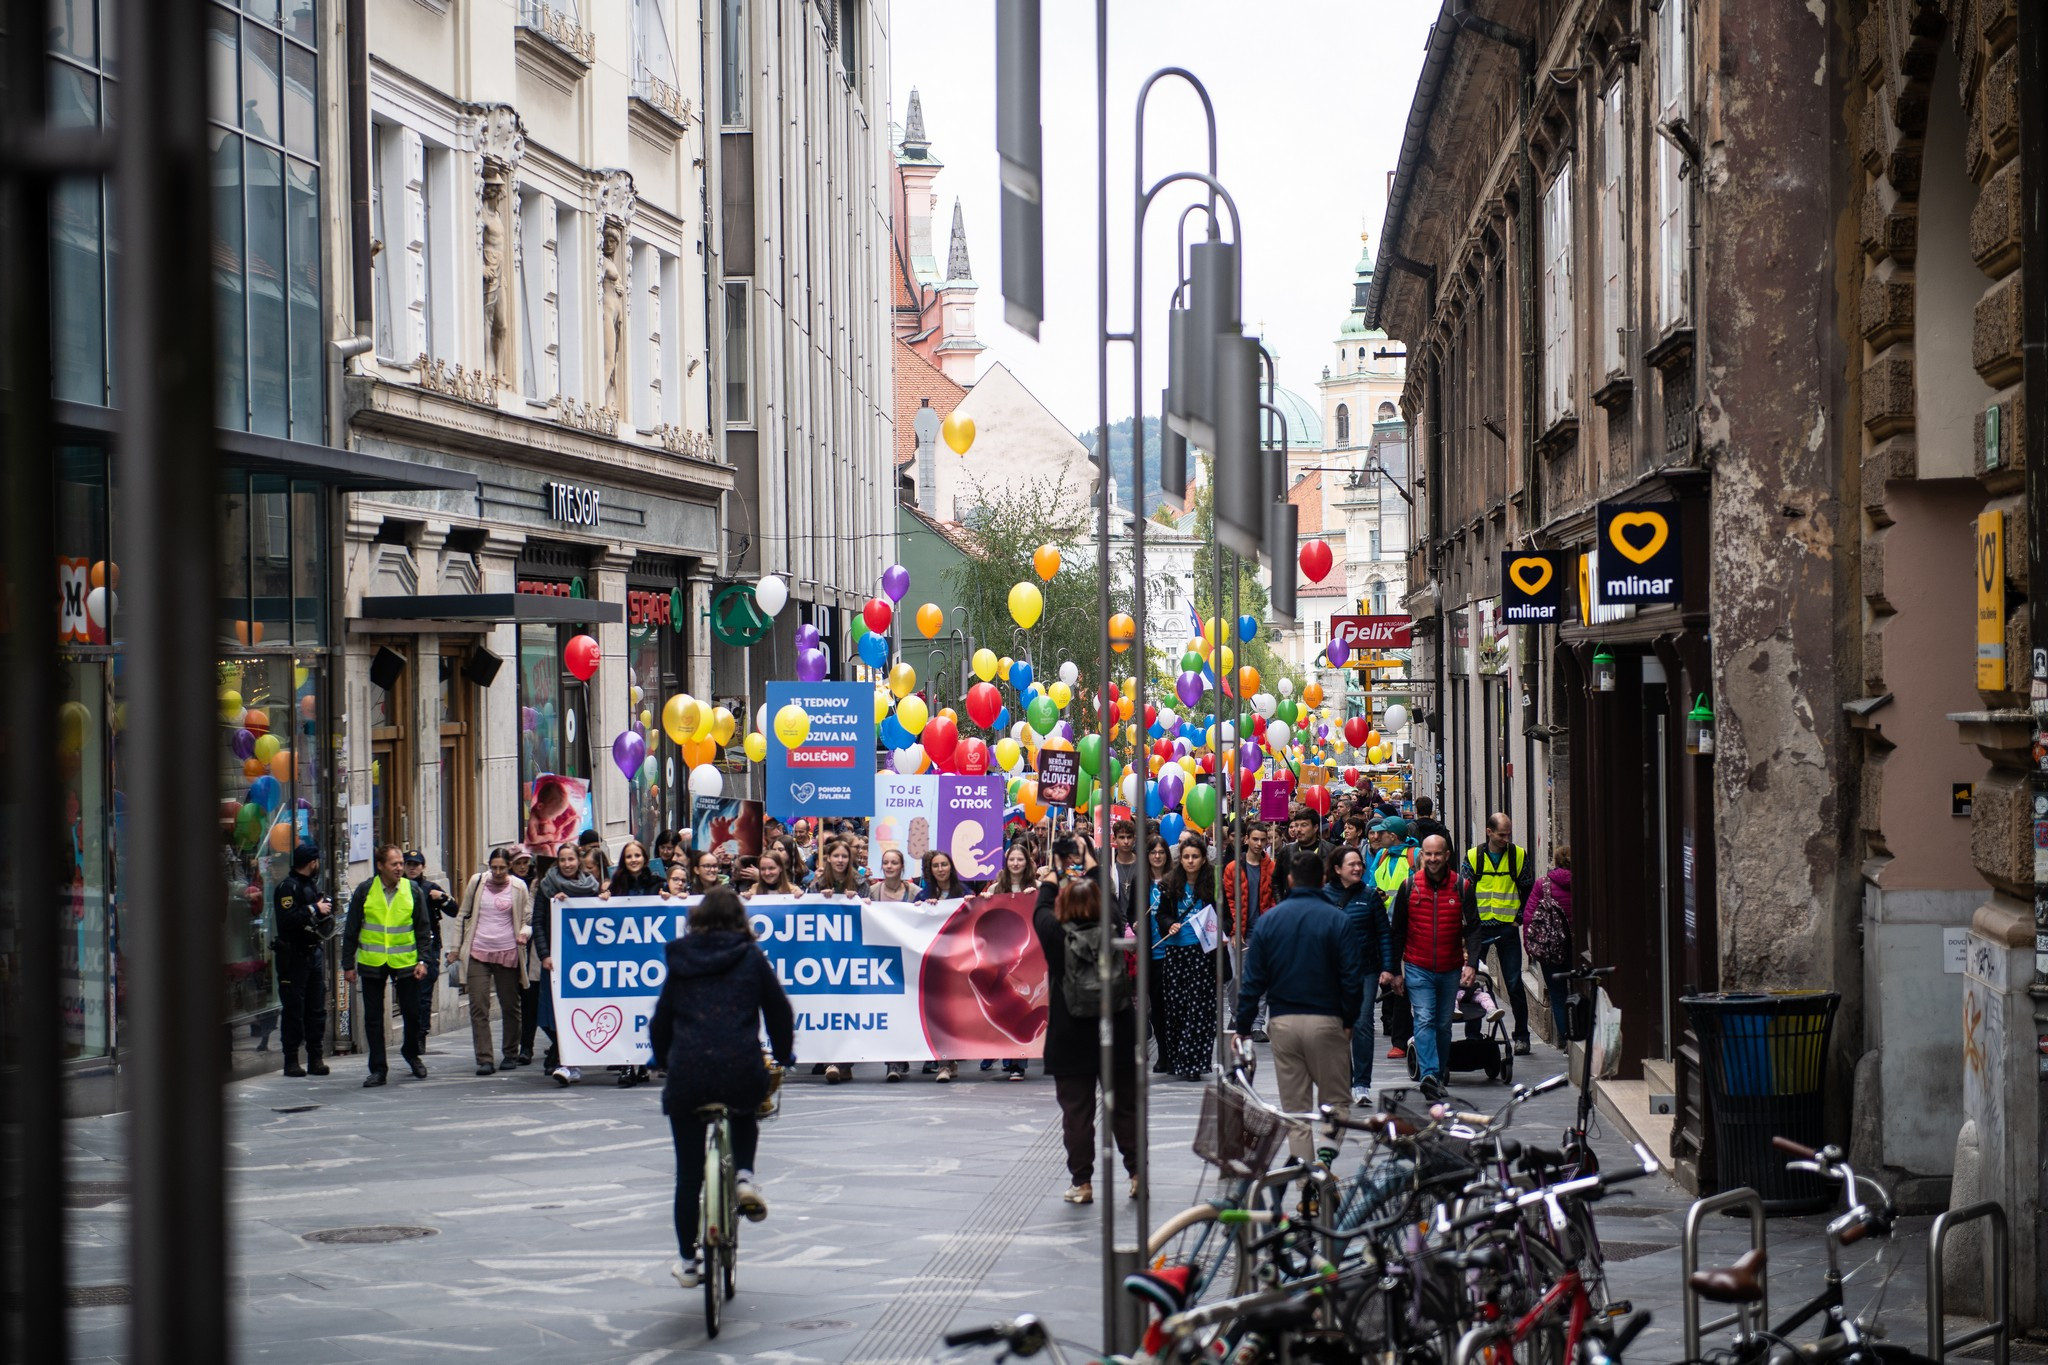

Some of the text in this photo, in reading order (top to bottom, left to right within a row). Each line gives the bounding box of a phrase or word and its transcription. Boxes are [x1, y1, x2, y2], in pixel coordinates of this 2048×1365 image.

[550, 482, 600, 526] TRESOR
[1607, 575, 1673, 596] mlinar
[628, 590, 671, 626] SPAR
[1508, 604, 1556, 619] mlinar
[1334, 621, 1395, 644] Felix
[790, 697, 849, 708] 15 TEDNOV
[808, 713, 858, 724] POČETJU
[805, 732, 839, 742] DZIVA
[841, 732, 858, 742] NA
[793, 750, 849, 762] BOLEČINO
[1048, 758, 1073, 767] NEROJENI
[1041, 770, 1076, 786] ČLOVEK!
[889, 785, 921, 795] TO JE
[955, 785, 988, 796] TO JE
[885, 798, 924, 808] IZBIRA
[950, 798, 993, 809] OTROK
[569, 916, 667, 945] VSAK
[569, 950, 895, 989] OTRO LOVEK
[794, 1013, 888, 1031] VLJENJE
